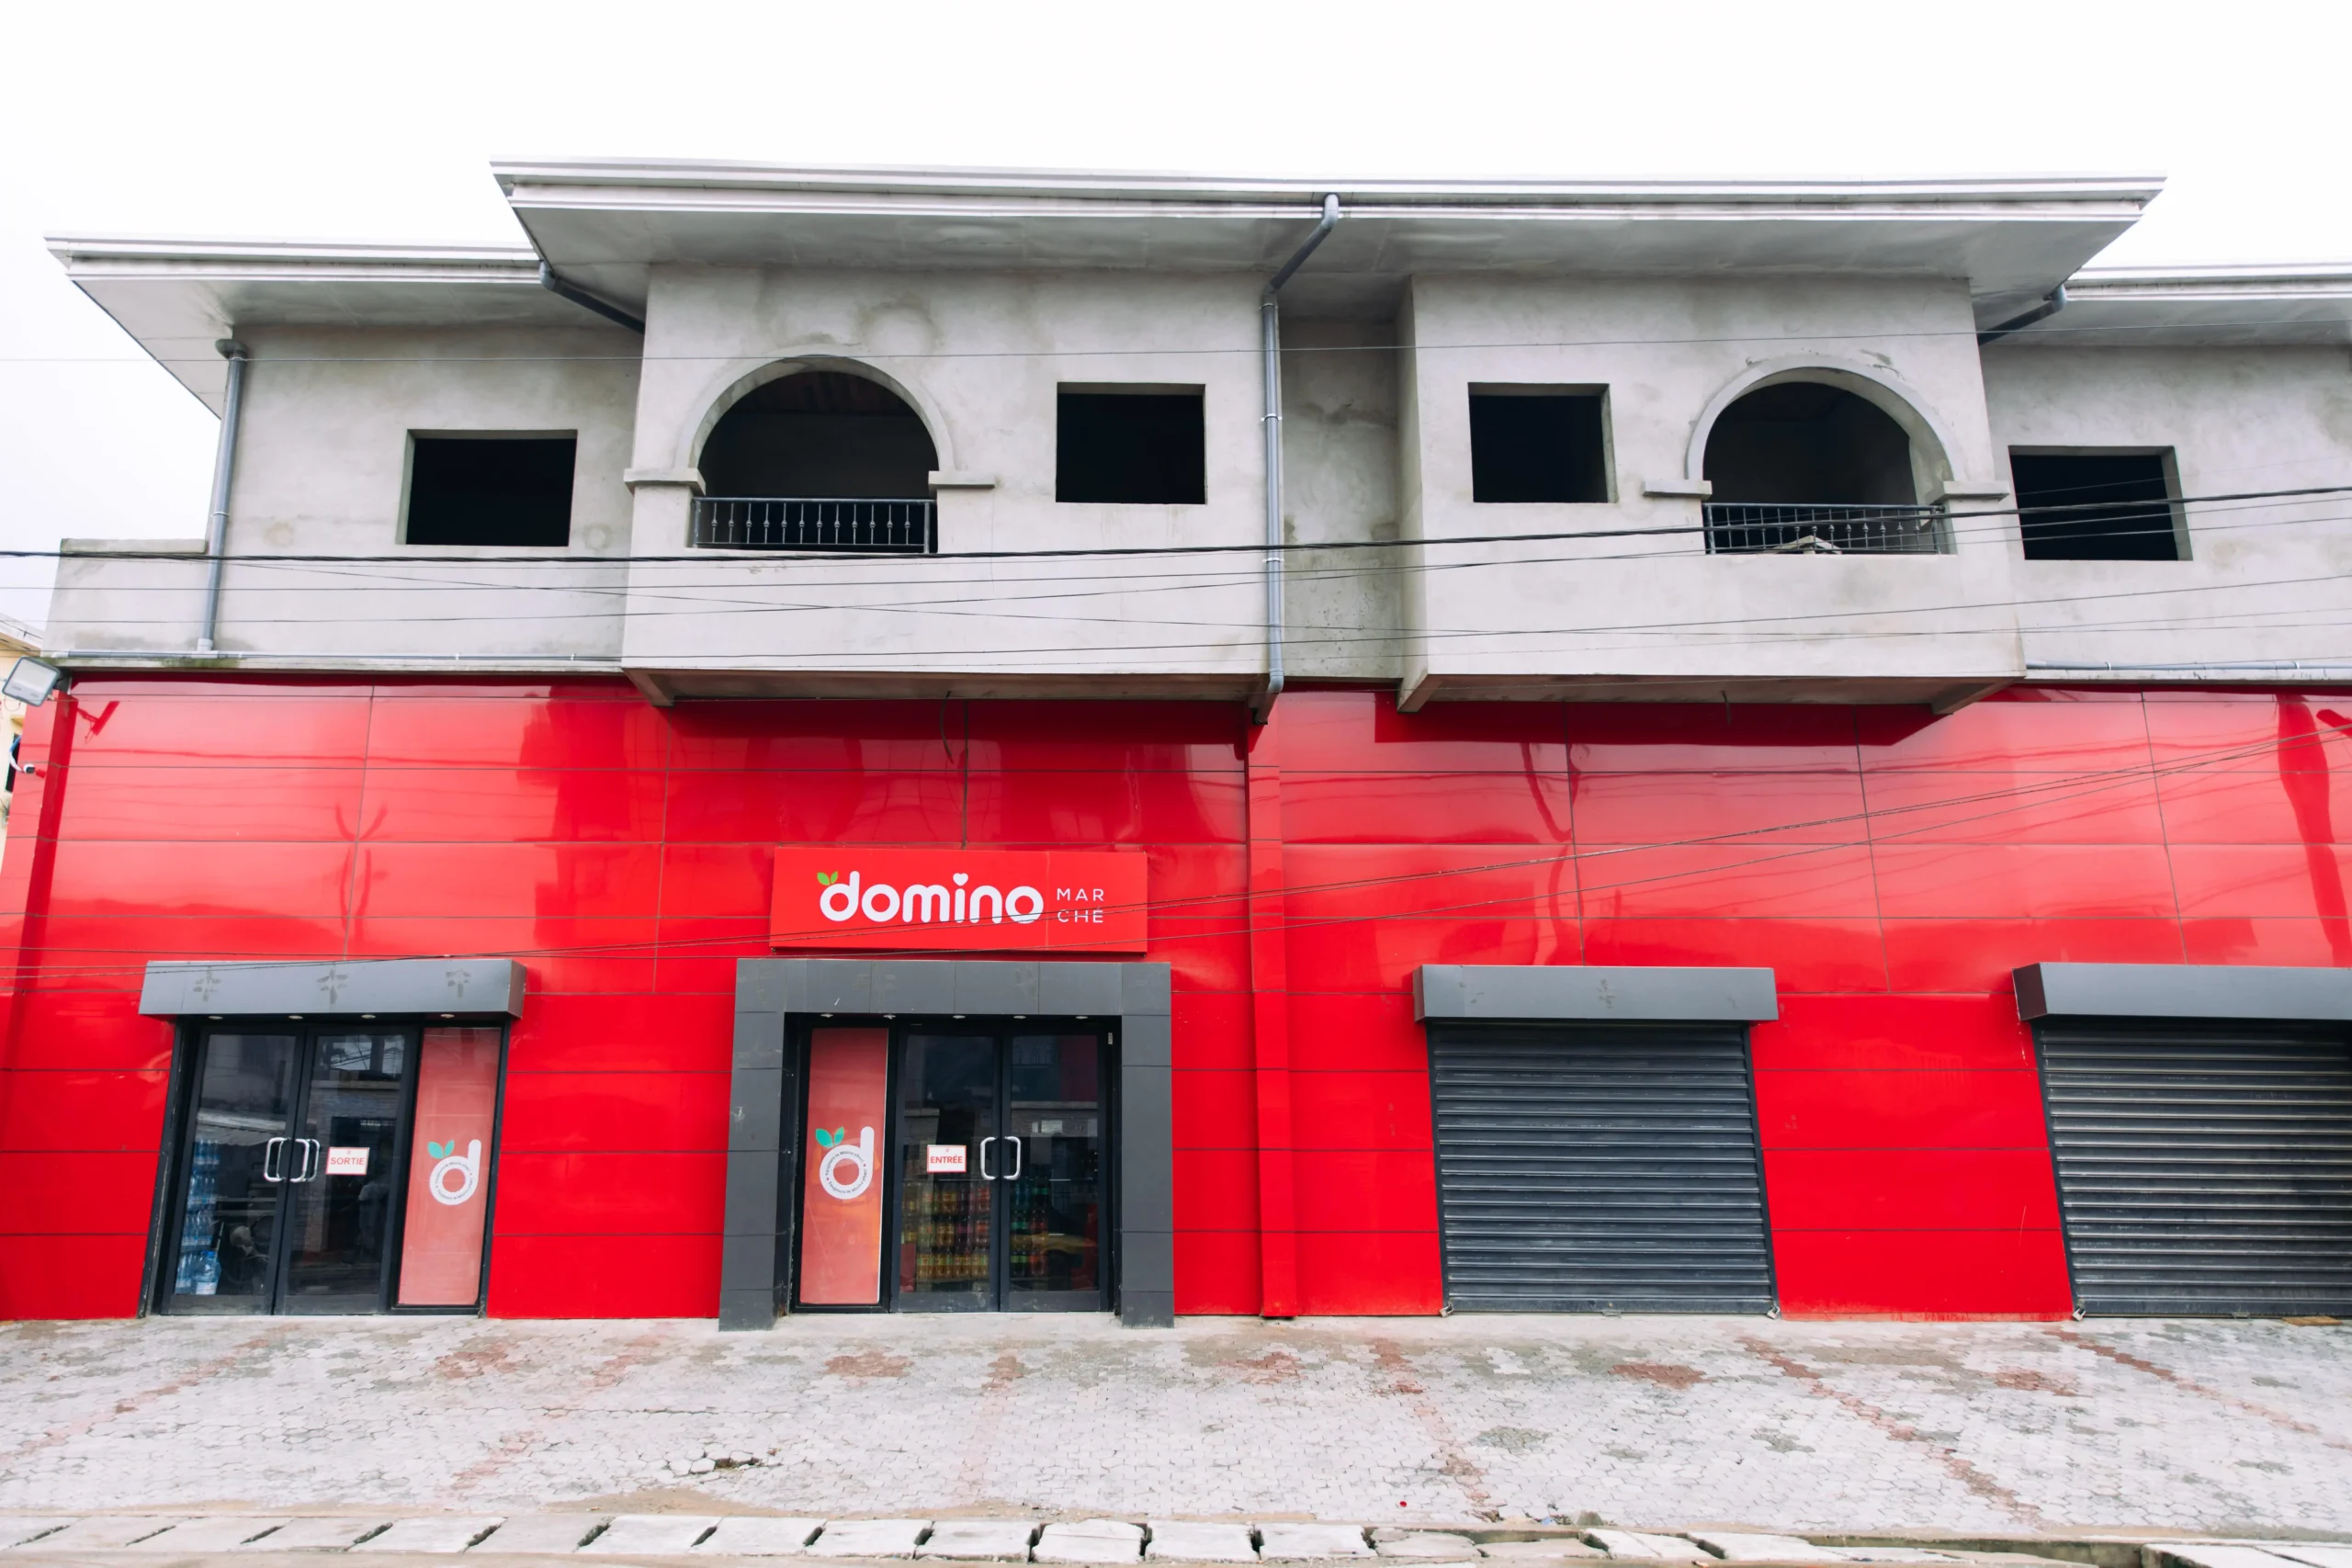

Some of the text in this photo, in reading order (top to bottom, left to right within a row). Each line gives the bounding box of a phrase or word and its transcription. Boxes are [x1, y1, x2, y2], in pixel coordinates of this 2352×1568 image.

[819, 870, 1044, 924] domino
[1057, 887, 1104, 901] MAR
[331, 1156, 365, 1165] SORTIE
[931, 1154, 963, 1164] ENTRÉE
